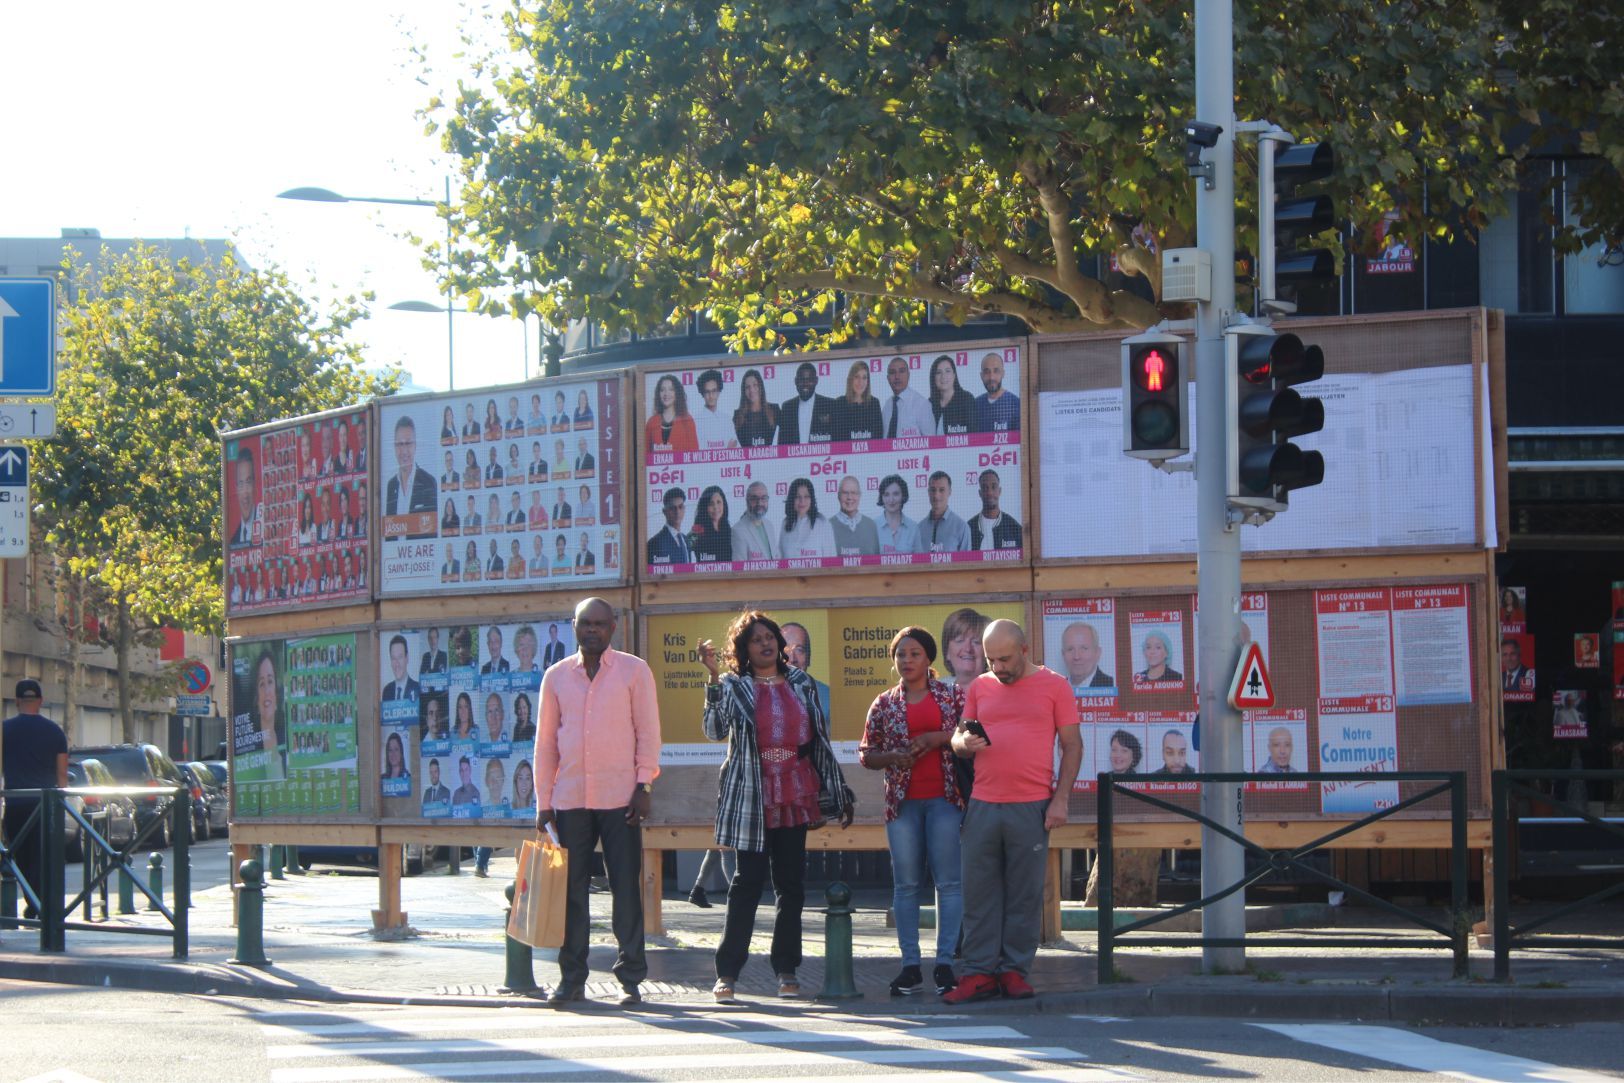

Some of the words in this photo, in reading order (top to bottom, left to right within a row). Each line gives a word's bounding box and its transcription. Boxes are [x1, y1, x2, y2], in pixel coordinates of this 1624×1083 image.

[1368, 263, 1411, 272] JABOUR
[892, 438, 929, 450] GHAZARIAN
[994, 432, 1008, 445] AZIZ
[852, 442, 868, 452] KAYA
[653, 454, 674, 465] ERKAN
[684, 452, 692, 463] DE
[693, 451, 712, 462] WILDE
[978, 447, 1018, 467] DéFI
[810, 456, 847, 476] DéFI
[897, 458, 919, 470] LISTE
[922, 455, 930, 472] 4
[649, 466, 684, 485] DéFI
[720, 466, 740, 478] LISTE
[744, 464, 752, 480] 4
[248, 549, 262, 565] KIR
[398, 545, 412, 558] WE
[416, 544, 434, 558] ARE
[388, 561, 430, 574] SAINT-JOSSE
[1320, 593, 1336, 602] LISTE
[1338, 591, 1384, 600] COMMUNALE
[1395, 590, 1412, 598] LISTE
[1414, 587, 1460, 597] COMMUNALE
[1046, 606, 1091, 614] COMMUNALE
[1096, 598, 1112, 612] 13
[1248, 594, 1264, 609] 13
[1338, 602, 1350, 611] N°
[1354, 601, 1366, 610] 13
[1414, 598, 1426, 608] N°
[1430, 598, 1440, 608] 13
[1168, 611, 1180, 621] 13
[664, 633, 686, 647] Kris
[664, 650, 685, 664] Van
[664, 670, 704, 680] Lijsttrekker
[844, 667, 867, 676] Plaats
[868, 667, 874, 675] 2
[866, 678, 887, 686] place
[1082, 697, 1114, 707] BALSAT
[1375, 697, 1392, 711] 13
[382, 706, 418, 720] CLERCKX
[1082, 712, 1094, 722] 13
[1134, 712, 1145, 722] 13
[1186, 711, 1197, 722] 13
[1242, 710, 1250, 720] 3
[1292, 710, 1304, 720] 13
[1342, 726, 1372, 740] Notre
[1320, 742, 1396, 763] Commune
